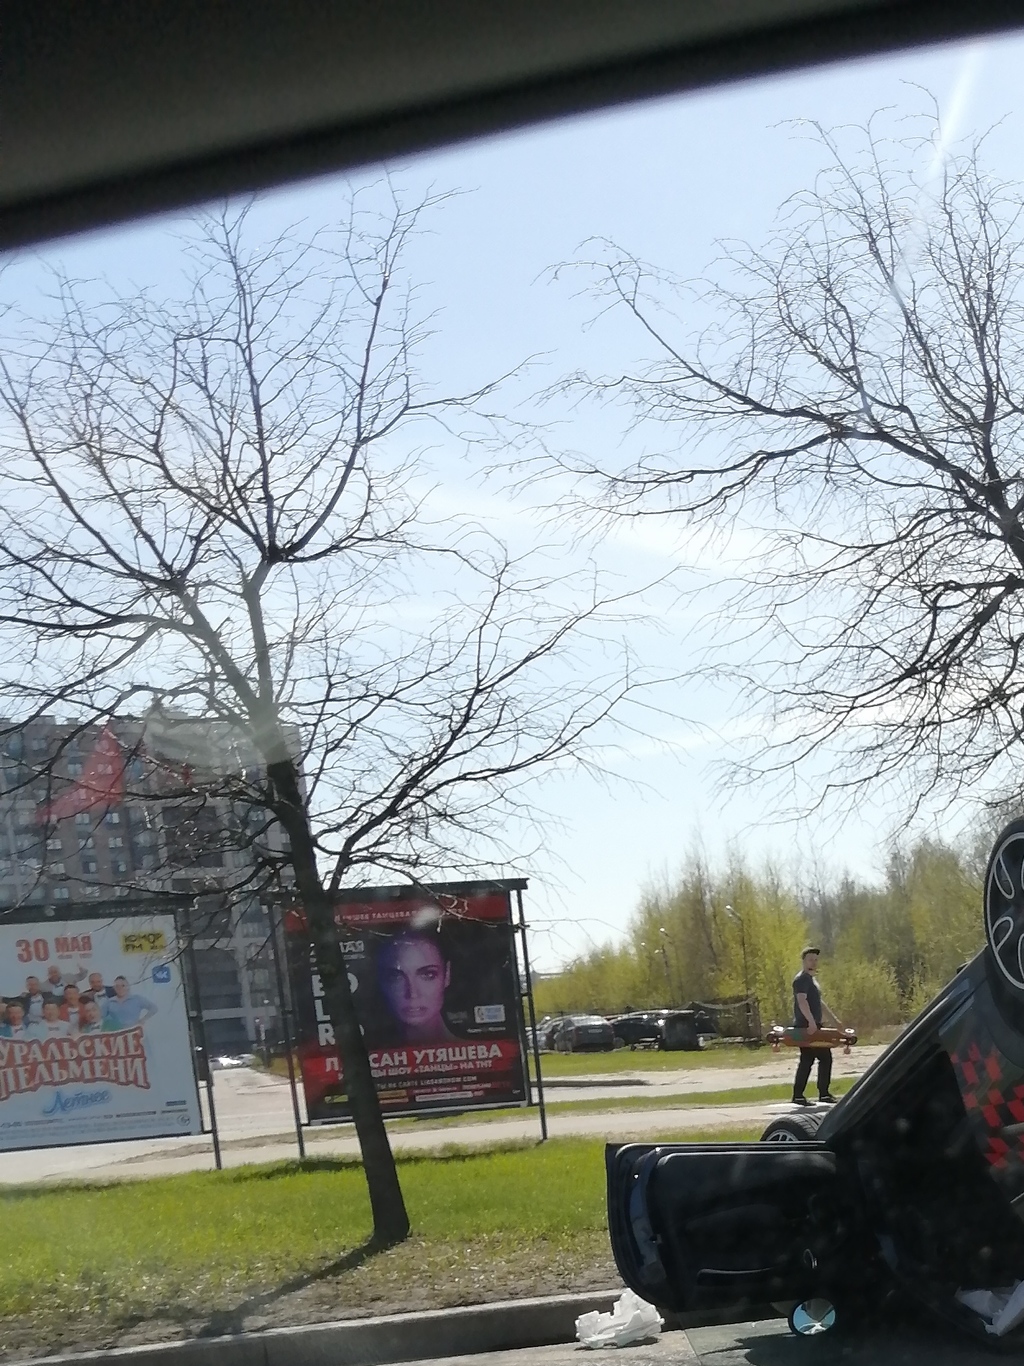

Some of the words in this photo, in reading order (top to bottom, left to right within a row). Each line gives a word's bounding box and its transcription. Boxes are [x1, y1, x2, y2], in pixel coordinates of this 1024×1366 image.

[16, 938, 49, 962] 30
[54, 935, 92, 953] МАЯ
[413, 1044, 503, 1064] УТЯШЕВА
[0, 1058, 147, 1099] ПЕЛЬМЕНИ
